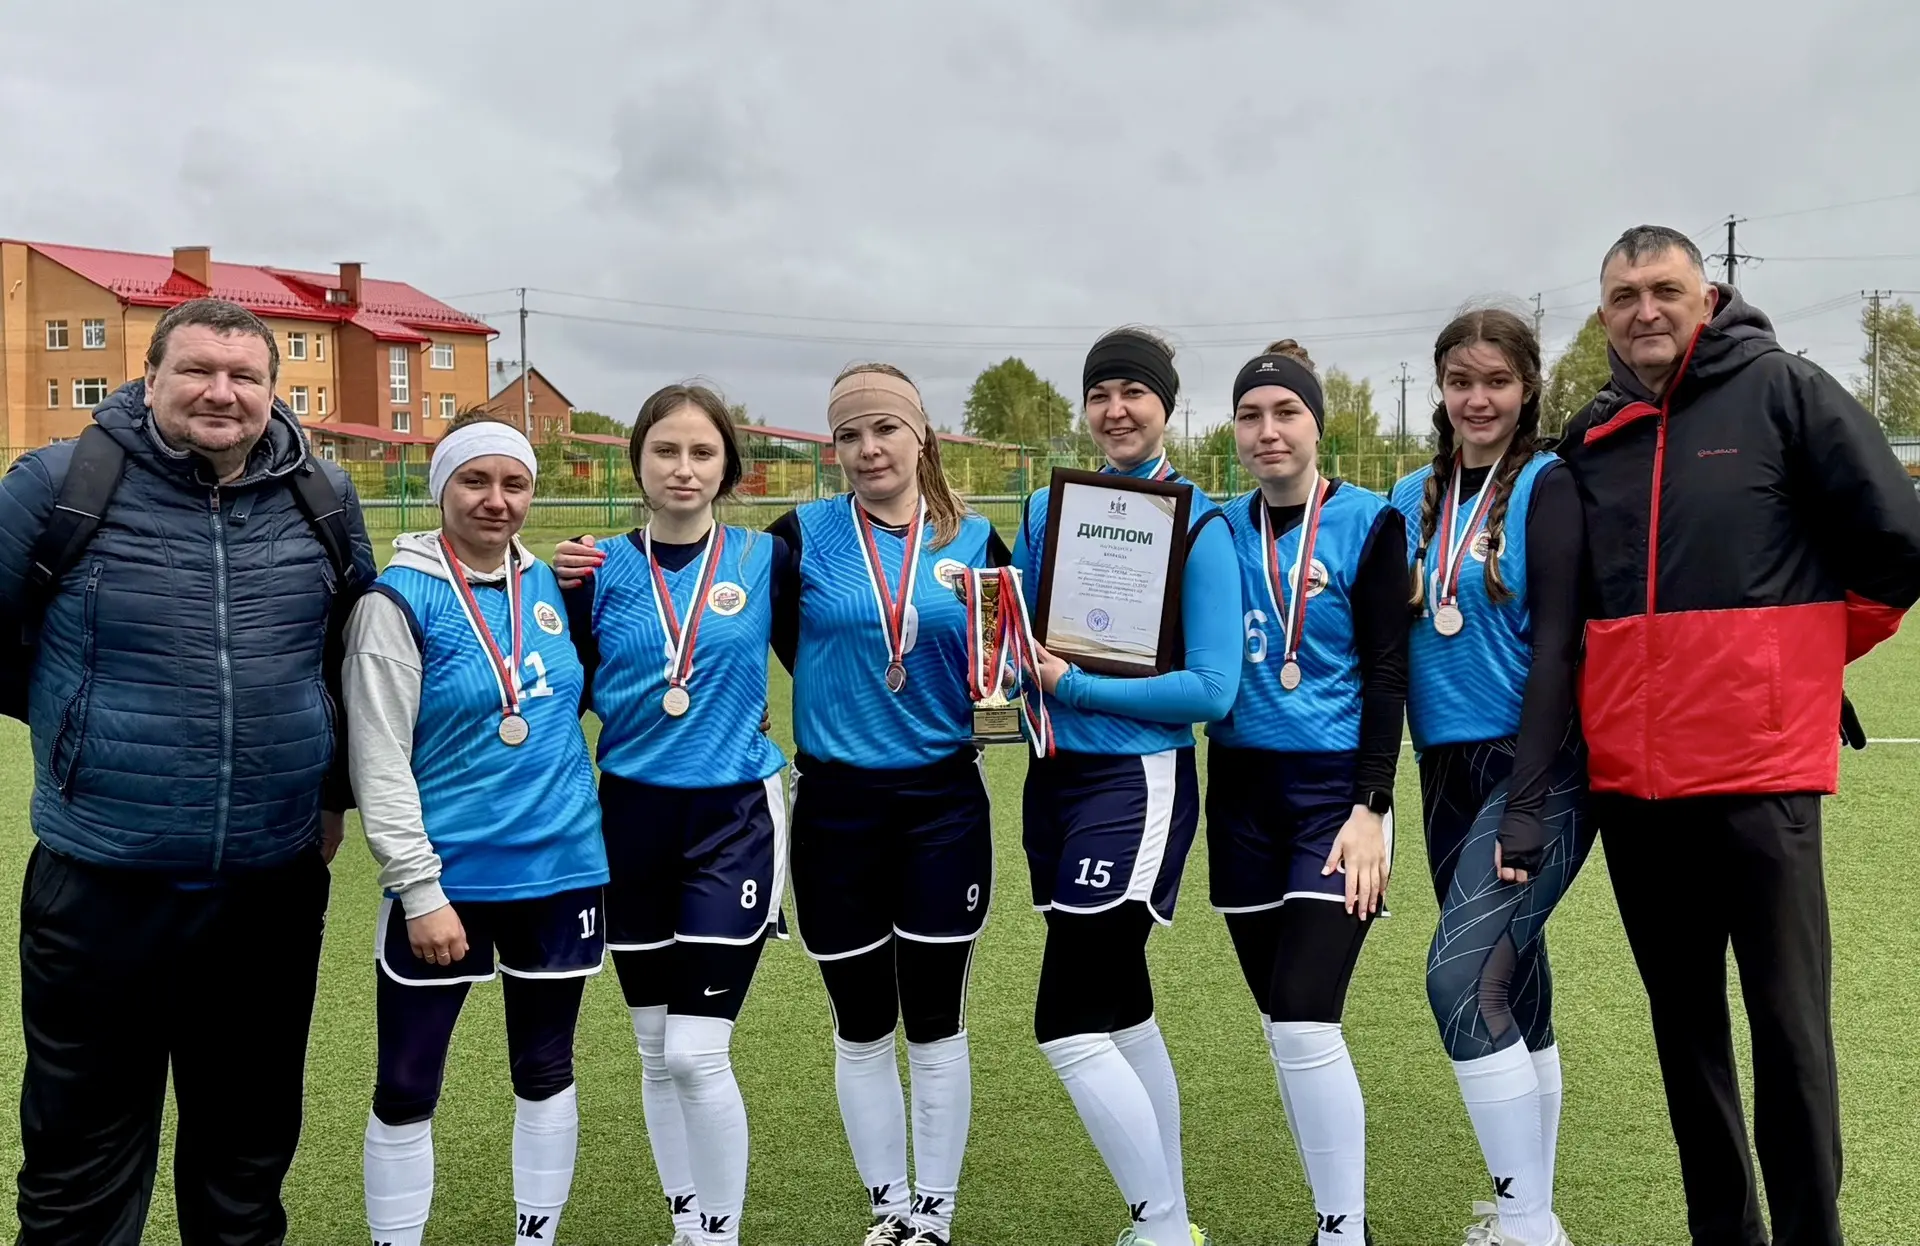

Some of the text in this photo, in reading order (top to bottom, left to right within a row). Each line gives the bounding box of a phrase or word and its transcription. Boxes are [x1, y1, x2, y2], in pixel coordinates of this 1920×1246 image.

[1077, 523, 1153, 545] ДИПЛОМ
[1244, 609, 1268, 663] 6
[1074, 857, 1114, 888] 15
[741, 879, 757, 909] 8
[967, 883, 979, 912] 9
[578, 907, 596, 939] 11
